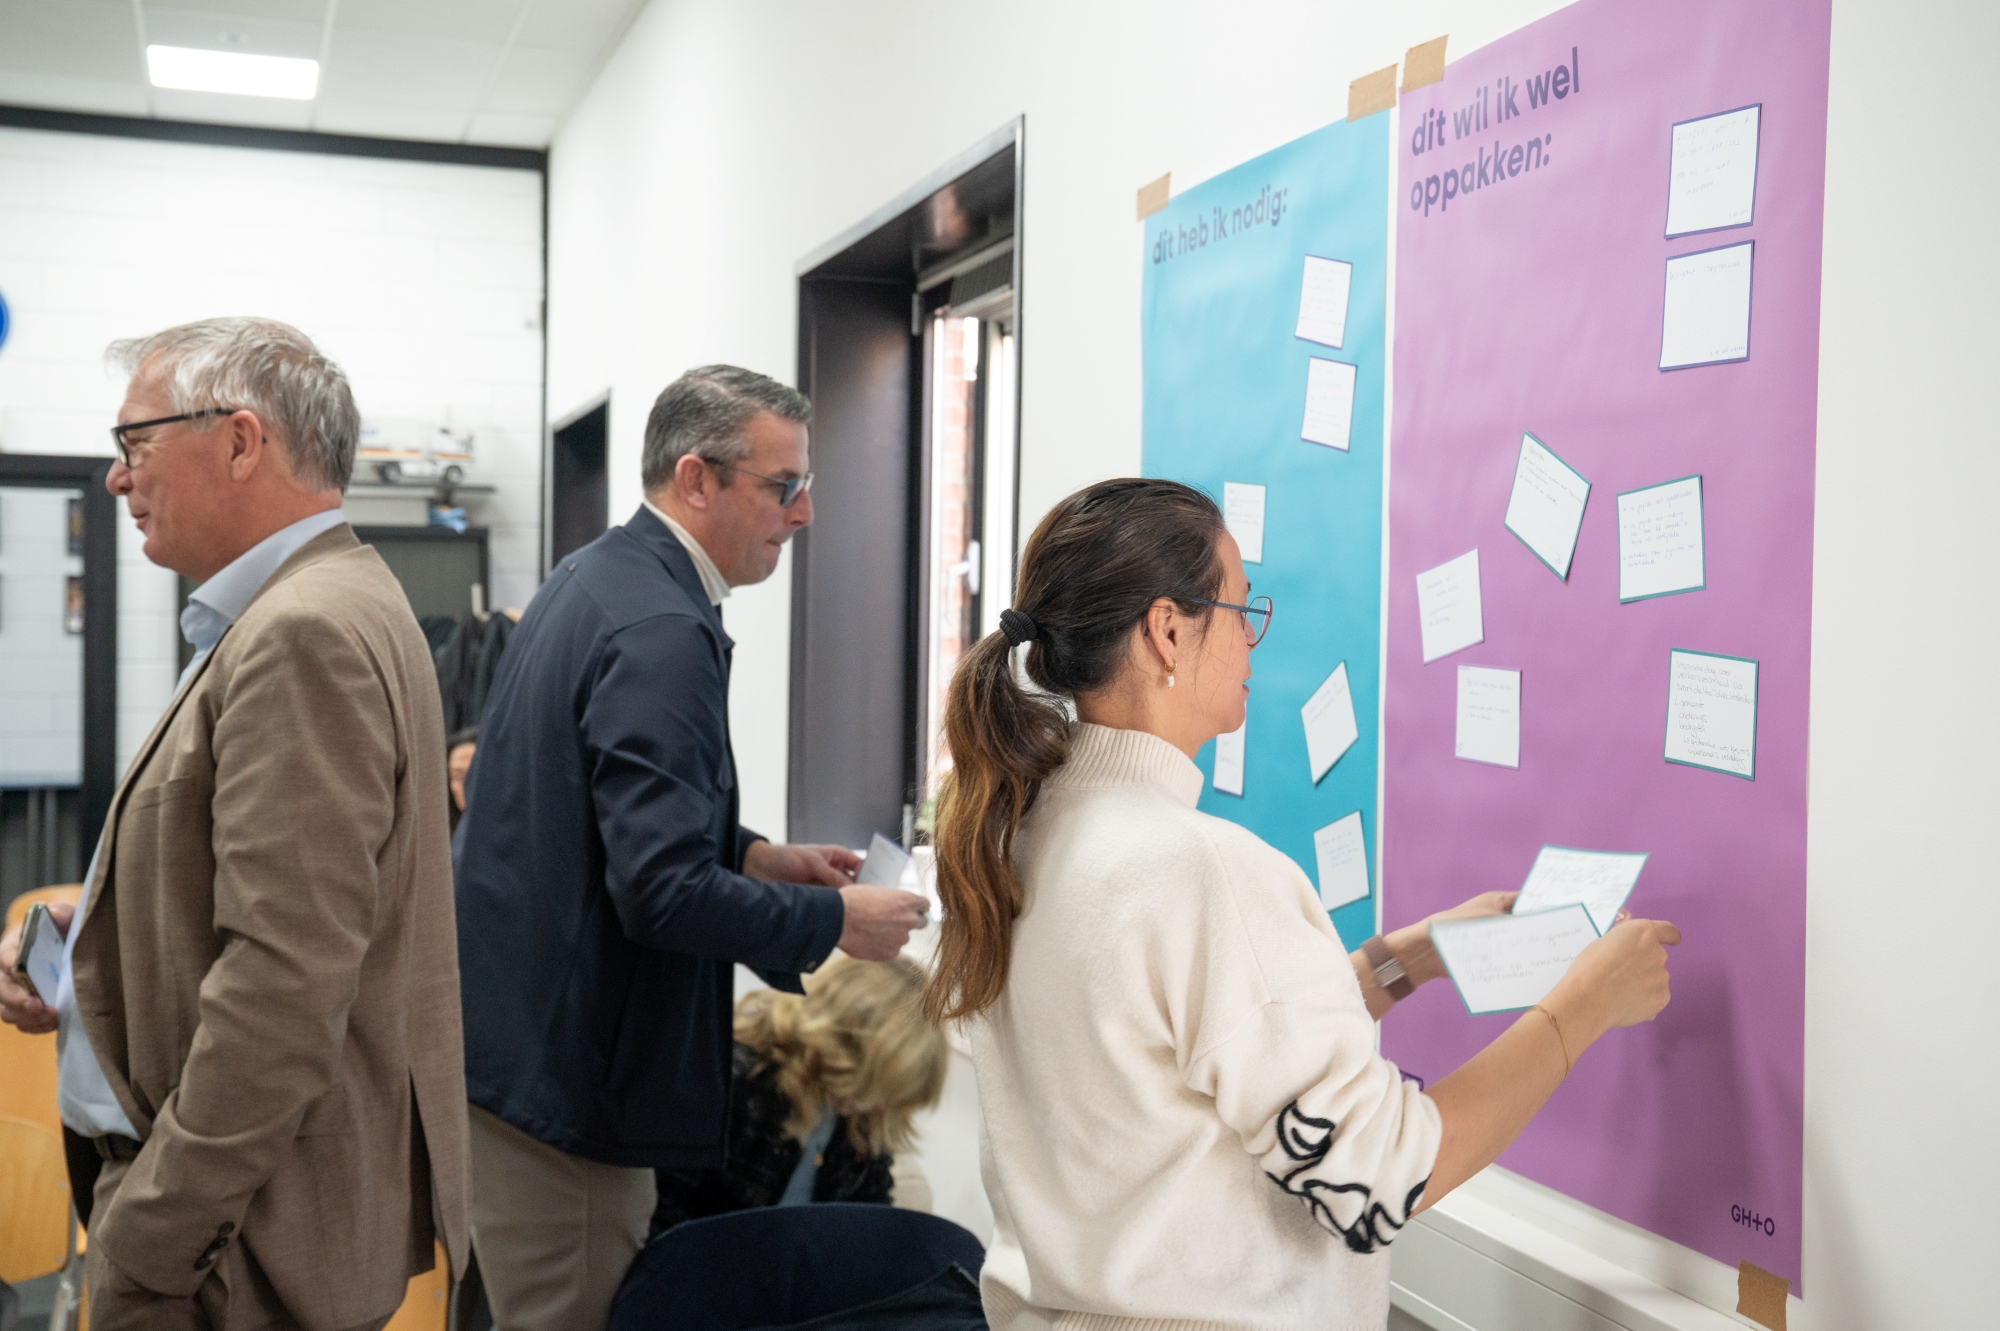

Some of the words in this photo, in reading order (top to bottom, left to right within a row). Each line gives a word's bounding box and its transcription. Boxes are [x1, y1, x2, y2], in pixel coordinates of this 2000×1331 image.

[1411, 107, 1446, 156] dit
[1453, 85, 1488, 140] wil
[1497, 75, 1520, 124] ik
[1525, 46, 1579, 110] wel
[1410, 133, 1552, 218] oppakken:
[1152, 229, 1174, 265] dit
[1178, 214, 1208, 256] heb
[1213, 206, 1227, 242] ik
[1232, 184, 1288, 227] nodig:
[1731, 1204, 1775, 1237] GH+O
